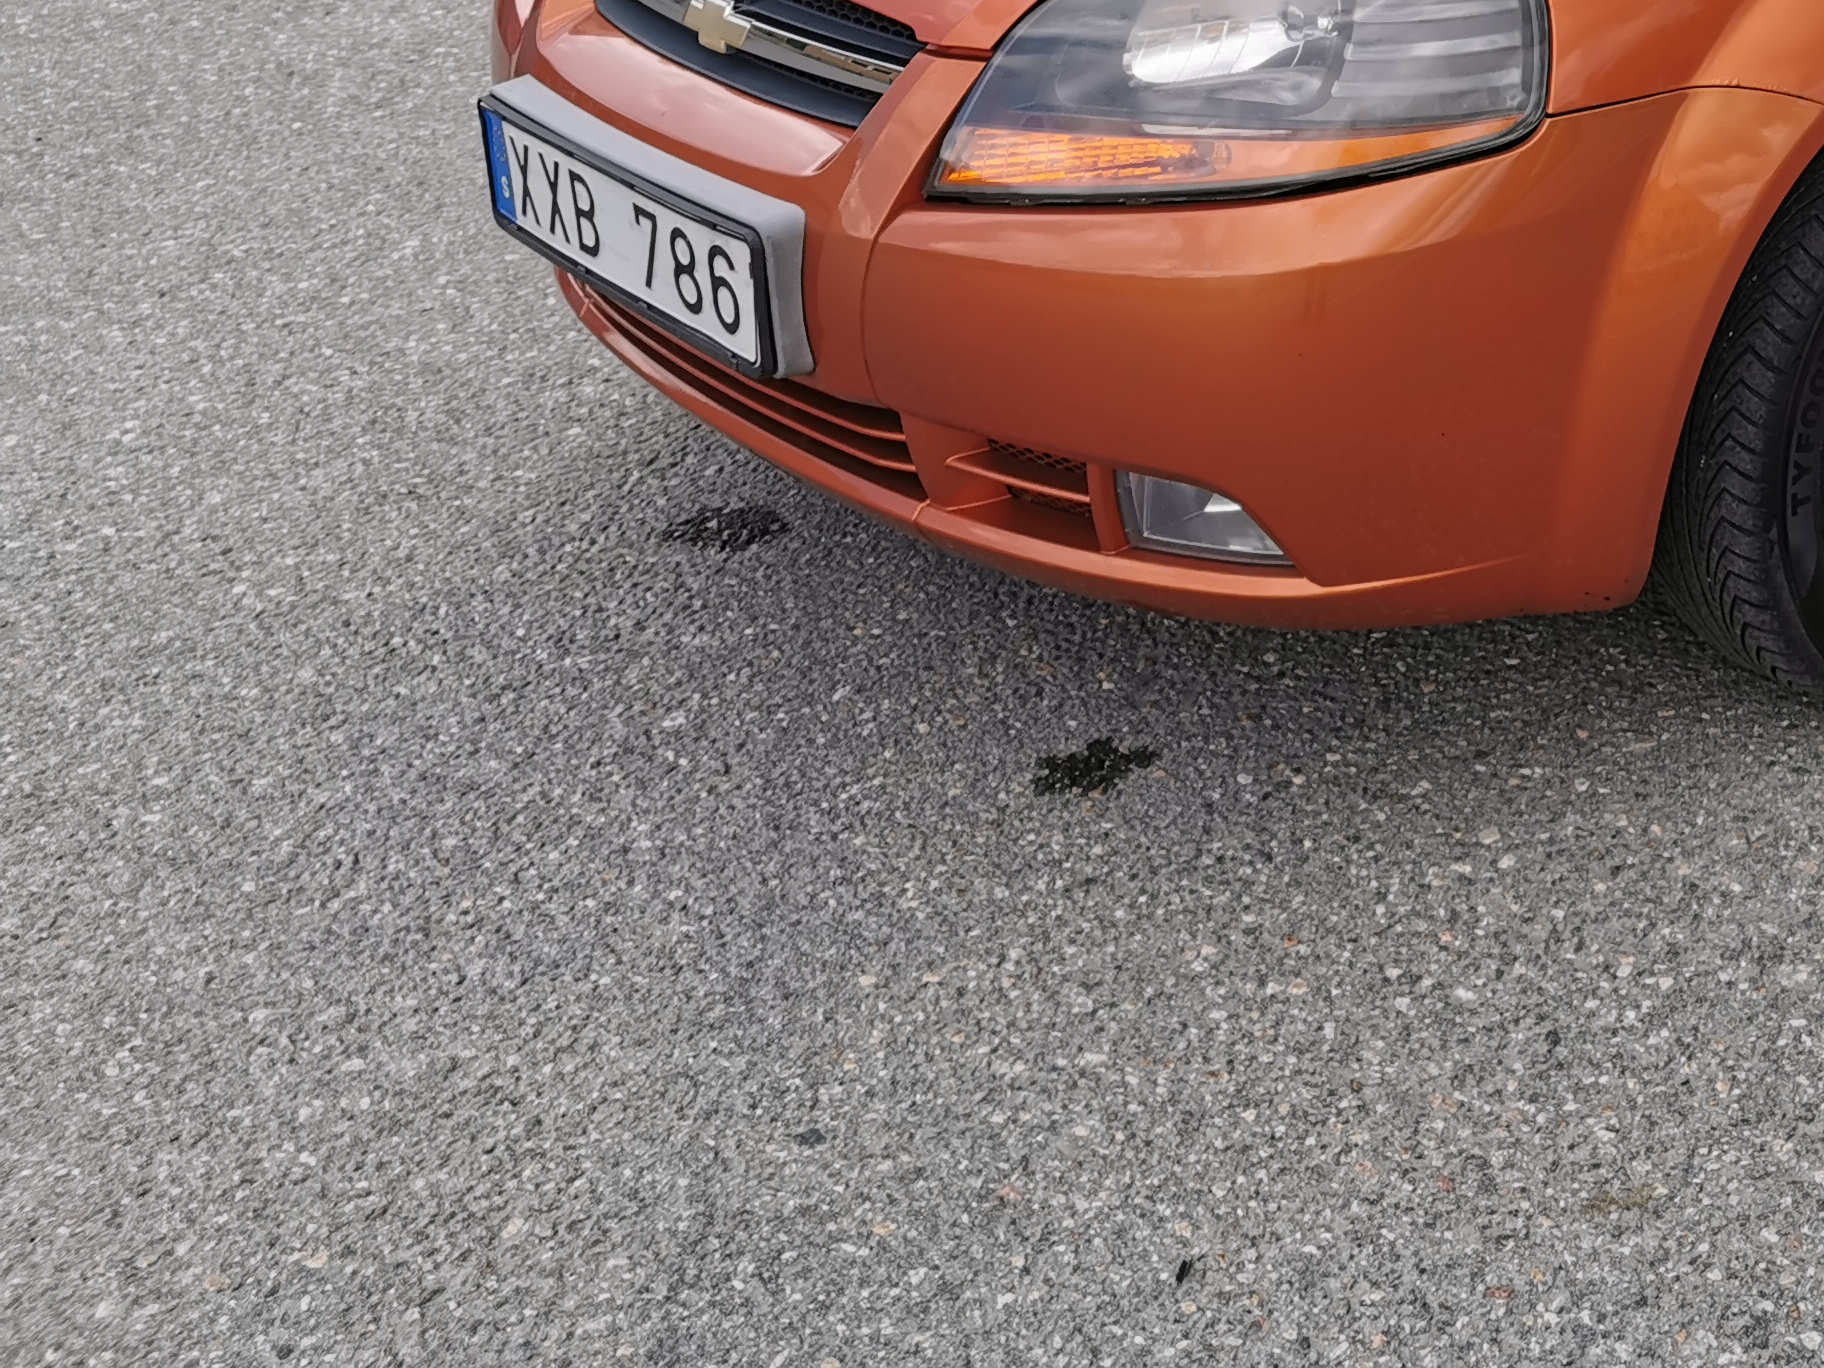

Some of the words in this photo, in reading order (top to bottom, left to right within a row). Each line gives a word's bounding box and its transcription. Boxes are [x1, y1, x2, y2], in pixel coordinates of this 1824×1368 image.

[501, 175, 511, 199] S
[508, 134, 601, 258] XXB
[632, 201, 740, 336] 786
